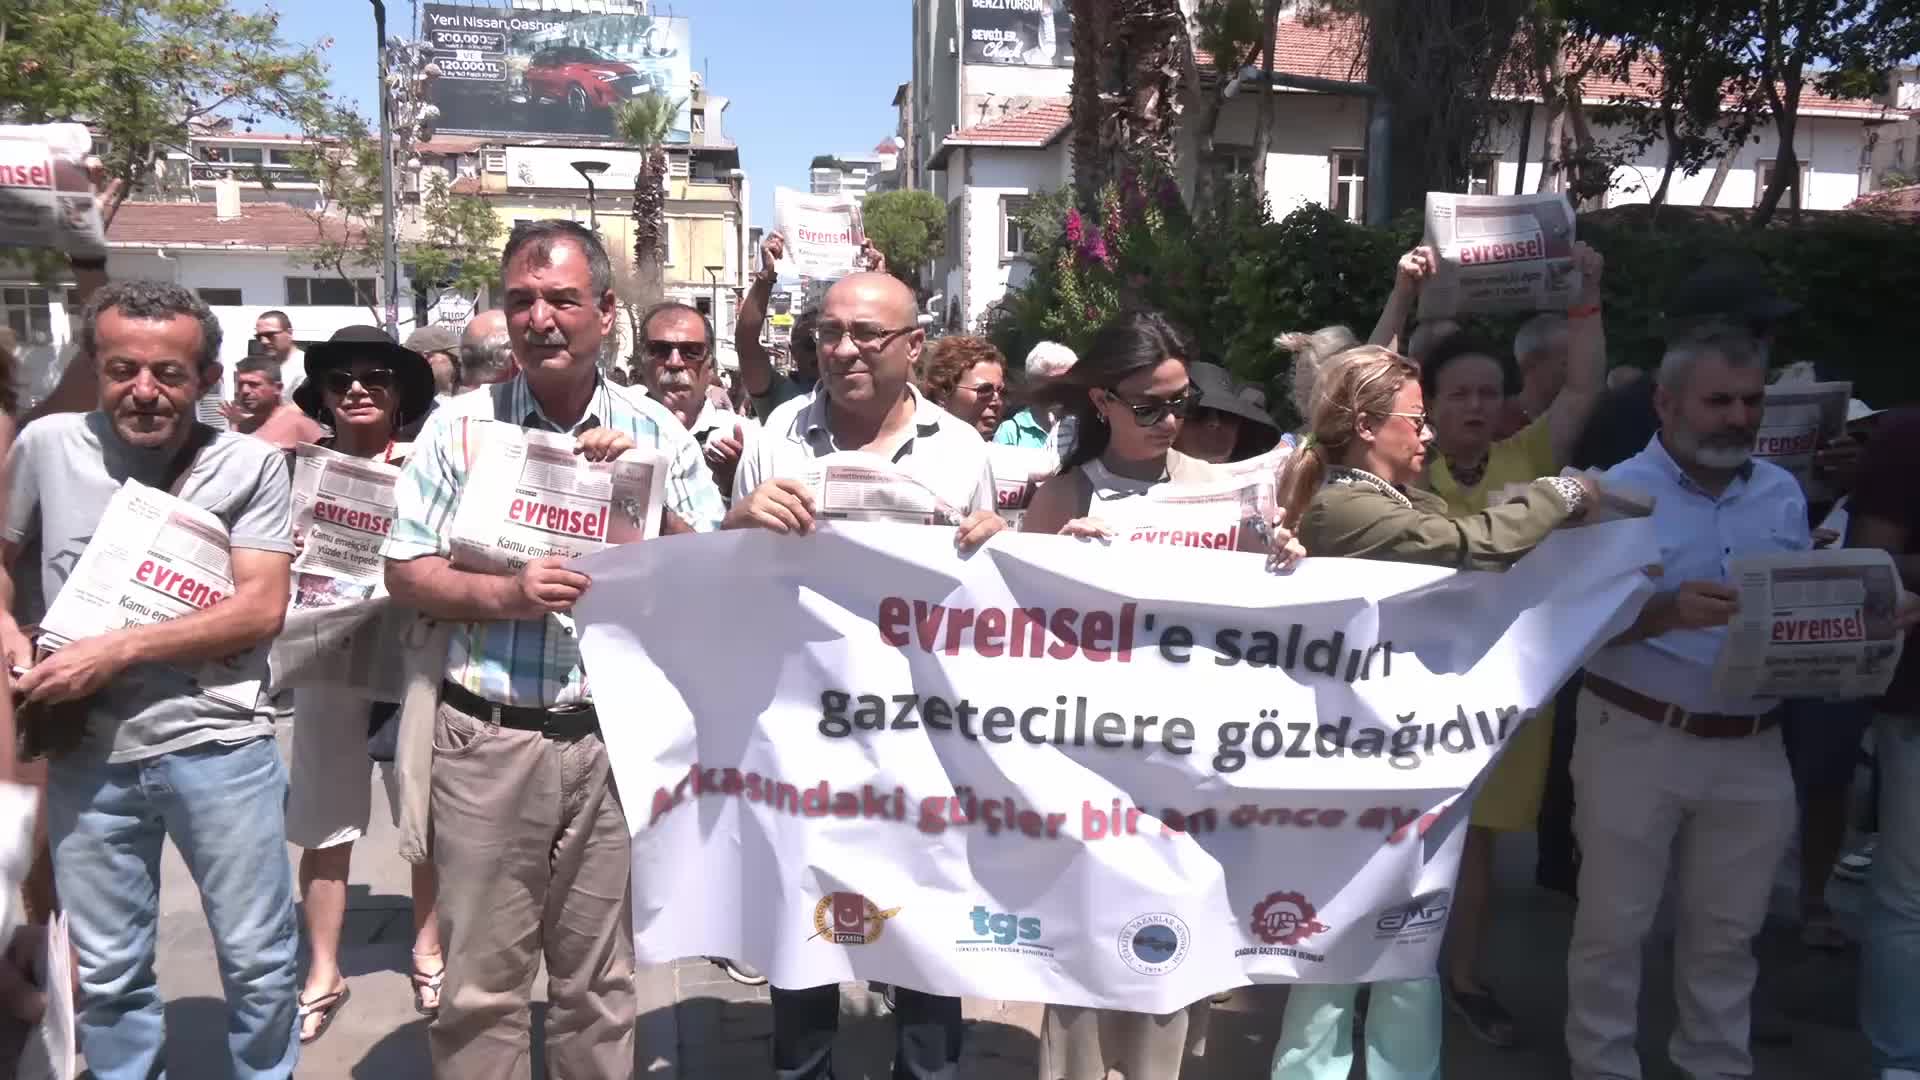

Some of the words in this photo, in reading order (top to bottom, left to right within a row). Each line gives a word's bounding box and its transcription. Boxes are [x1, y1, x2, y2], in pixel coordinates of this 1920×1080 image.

[430, 13, 460, 26] Yeni
[463, 16, 508, 29] Nissan
[437, 33, 488, 44] 200.000
[798, 228, 851, 244] evrensel
[1460, 232, 1544, 263] evrensel
[509, 498, 607, 538] evrensel
[497, 536, 527, 554] Kamu
[1129, 525, 1237, 551] evrensel
[135, 560, 230, 610] evrens
[118, 594, 152, 616] Kamu
[878, 596, 1193, 664] evrensel'e
[1772, 608, 1864, 642] evrensel
[817, 688, 1196, 756] gazetecilere
[1212, 703, 1520, 773] gözdağıdır
[917, 786, 1068, 840] güçler
[1082, 798, 1144, 841] bir
[1160, 807, 1218, 839] an
[1228, 804, 1347, 829] önce
[969, 905, 1042, 945] tgs
